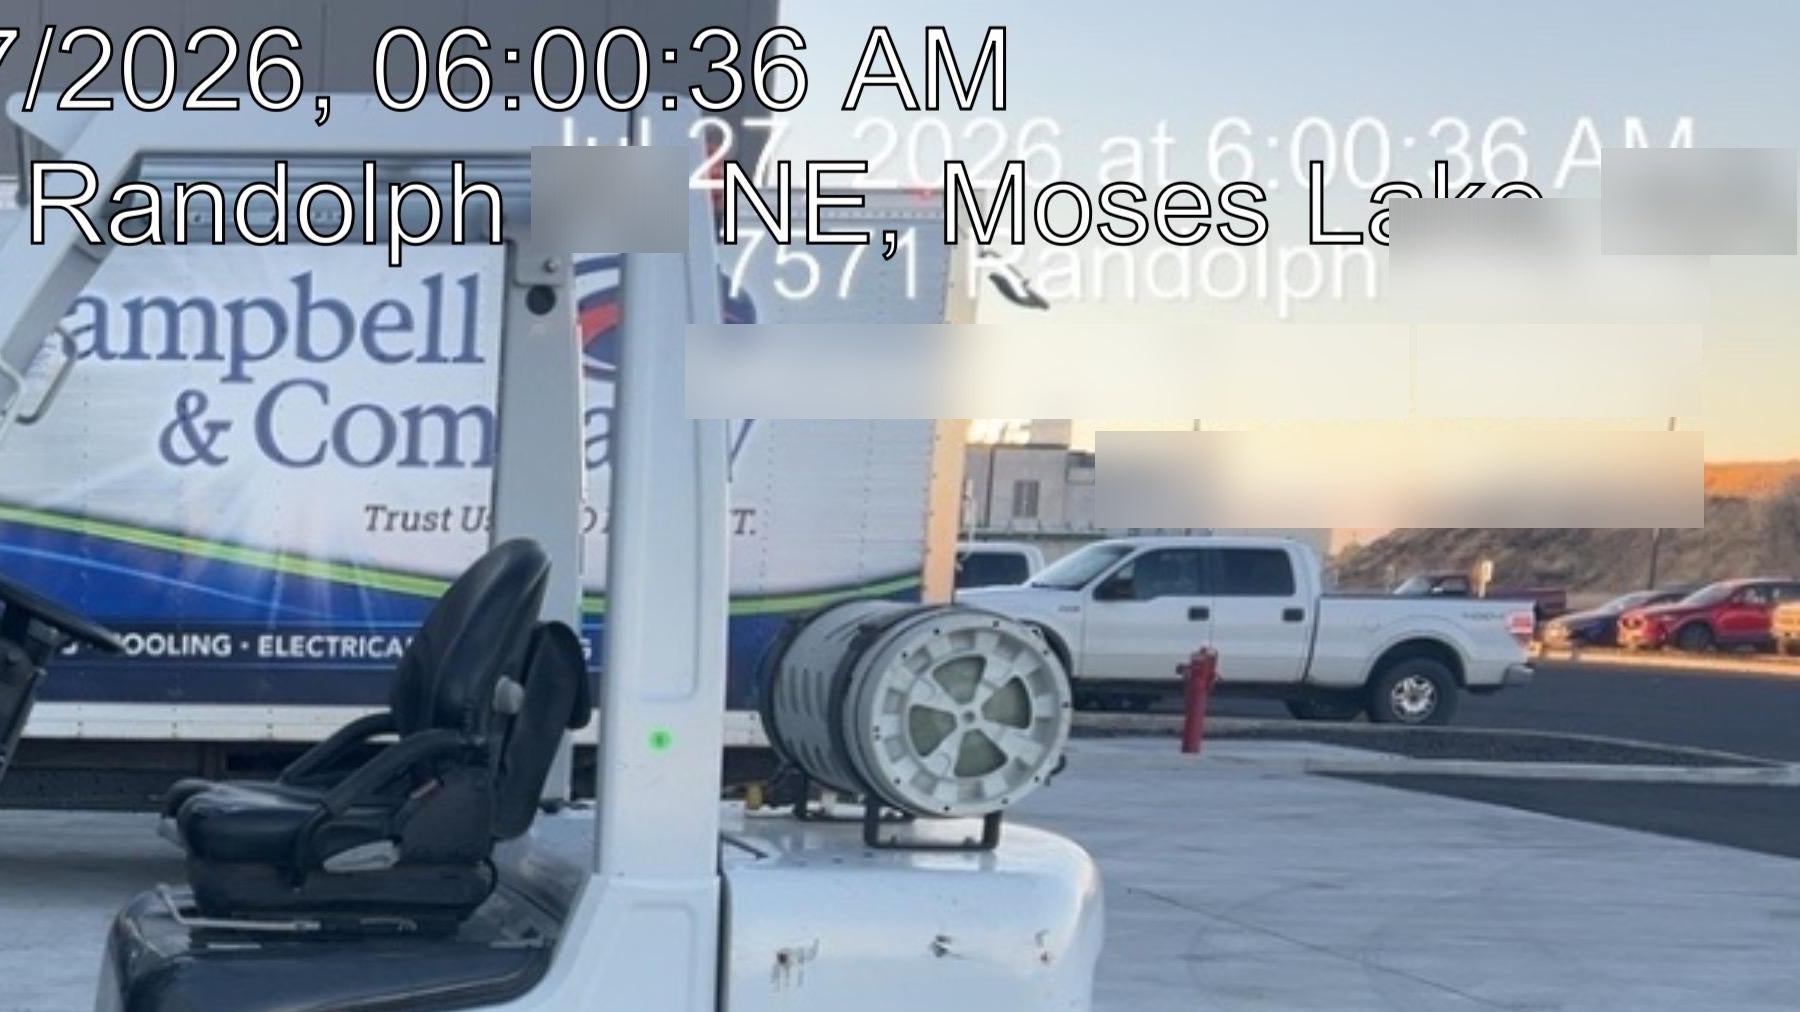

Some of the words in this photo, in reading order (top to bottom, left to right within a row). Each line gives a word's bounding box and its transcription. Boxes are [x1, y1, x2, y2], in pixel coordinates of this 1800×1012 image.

[68, 270, 486, 384] ampbell
[157, 388, 233, 467] &
[365, 504, 454, 533] Trust
[114, 631, 233, 658] OOLING
